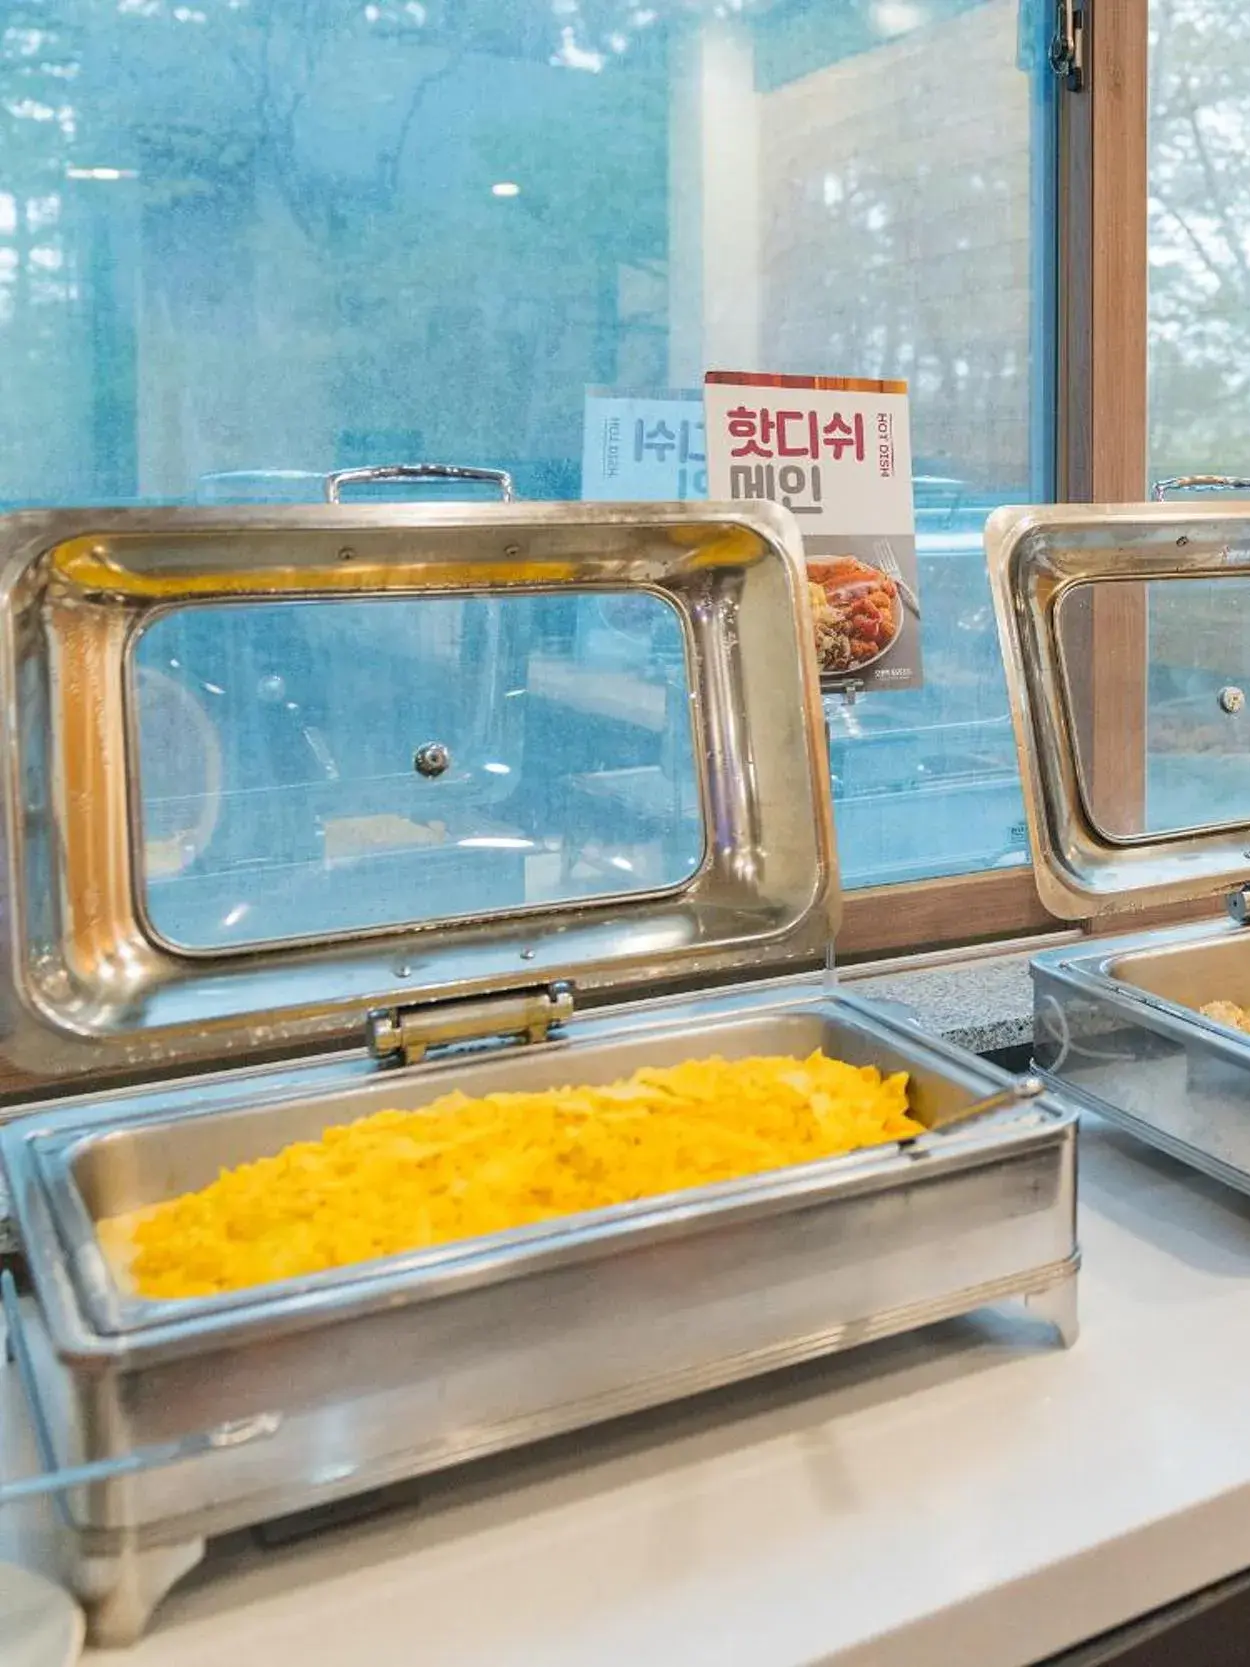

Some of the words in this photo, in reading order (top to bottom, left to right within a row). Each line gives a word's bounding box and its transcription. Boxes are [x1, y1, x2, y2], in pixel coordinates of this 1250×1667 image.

[727, 406, 864, 461] 핫디쉬
[876, 413, 888, 442] HOT
[880, 444, 890, 478] DISH
[730, 464, 823, 514] 메인
